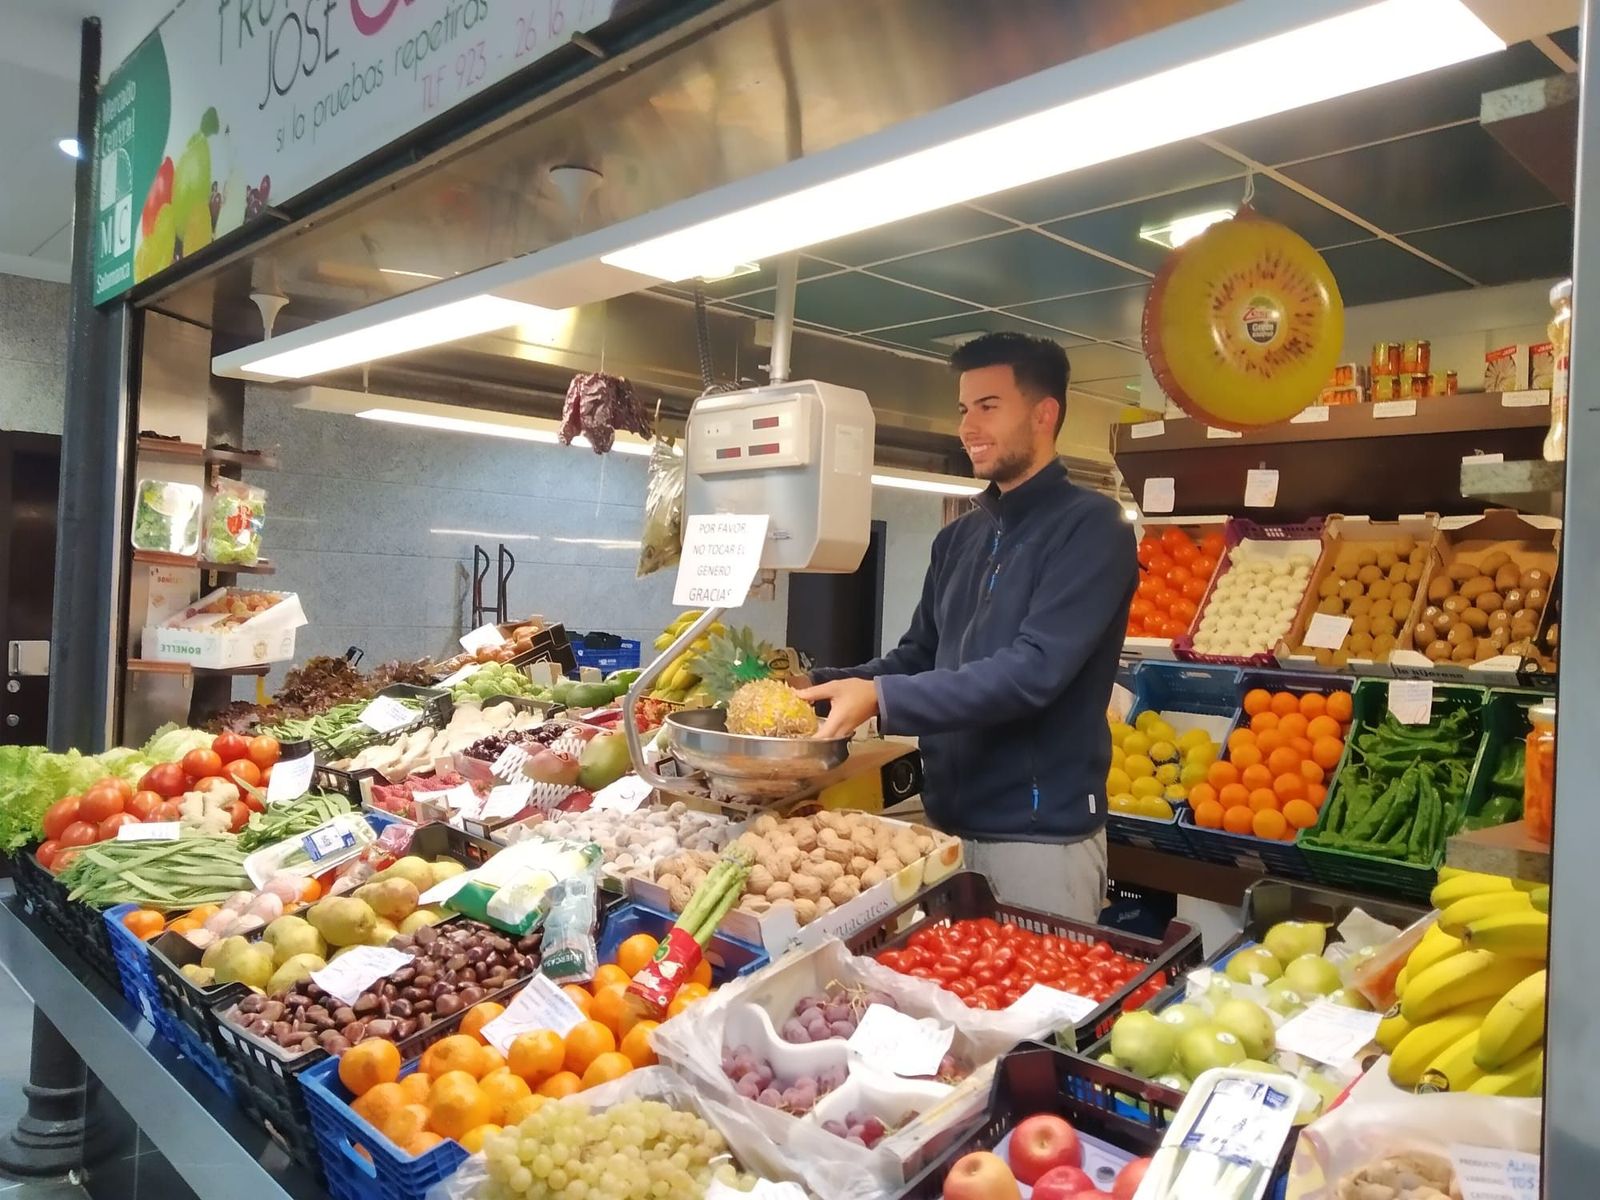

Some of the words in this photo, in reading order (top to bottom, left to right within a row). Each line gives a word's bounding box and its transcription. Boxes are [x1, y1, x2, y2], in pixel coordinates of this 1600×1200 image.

[422, 64, 447, 113] TLF
[456, 40, 487, 91] 923
[514, 9, 537, 58] 26
[313, 59, 384, 144] pruebas
[699, 523, 716, 534] POR
[718, 523, 746, 534] FAVOR
[693, 544, 706, 555] NO
[708, 544, 735, 555] TOCAR
[697, 565, 732, 576] GENERO
